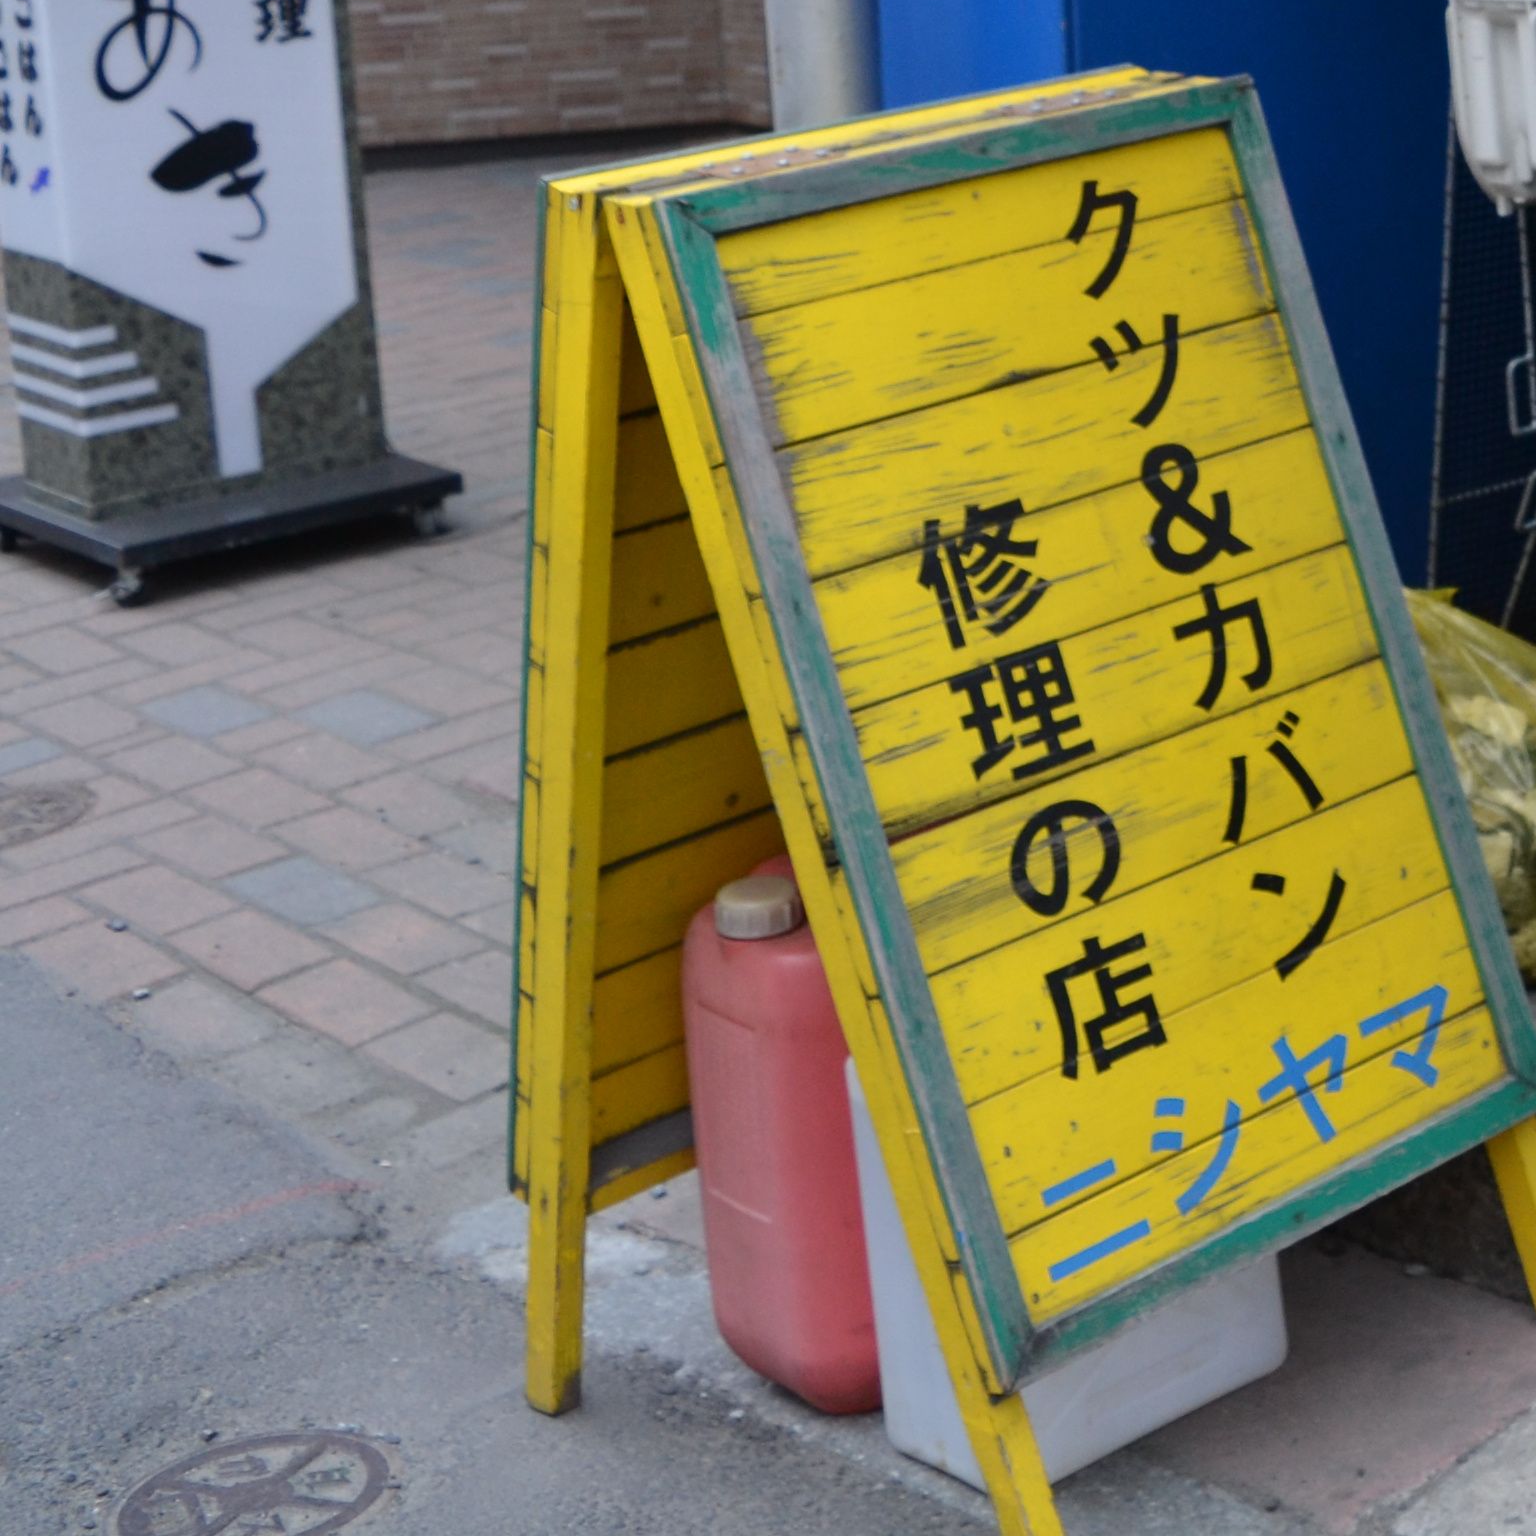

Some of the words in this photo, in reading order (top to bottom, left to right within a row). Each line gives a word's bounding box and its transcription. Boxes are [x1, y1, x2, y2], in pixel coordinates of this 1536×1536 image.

[916, 496, 1169, 1081] 修理の店
[1064, 177, 1347, 980] クツ&カバン
[1040, 983, 1450, 1282] ニシヤマ
